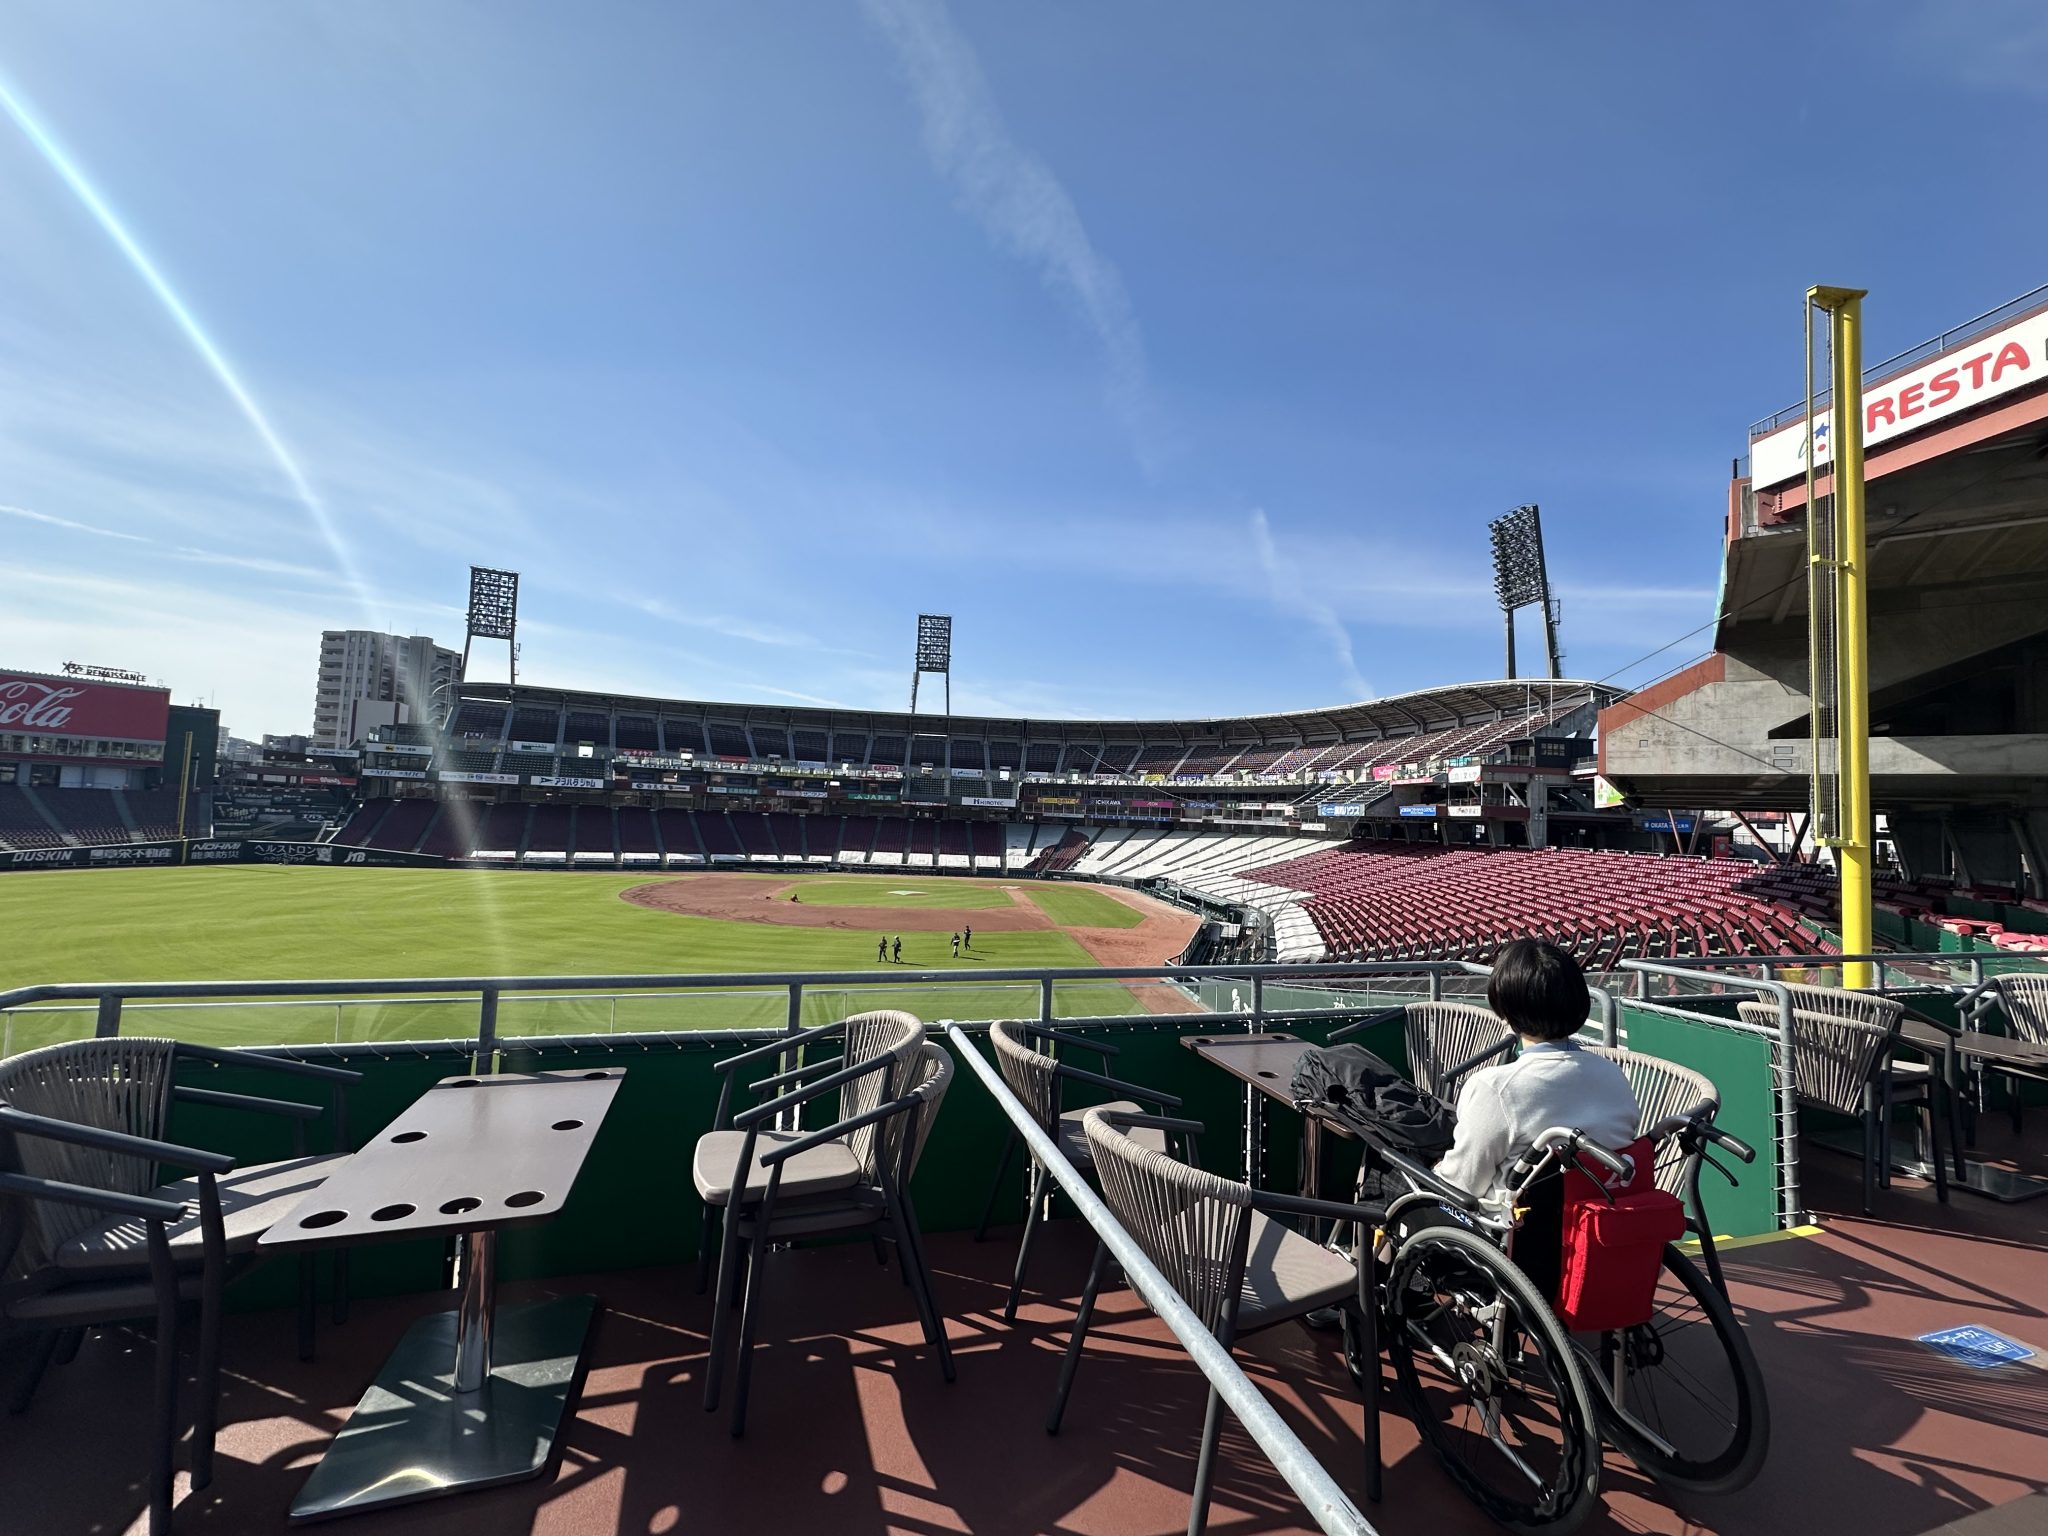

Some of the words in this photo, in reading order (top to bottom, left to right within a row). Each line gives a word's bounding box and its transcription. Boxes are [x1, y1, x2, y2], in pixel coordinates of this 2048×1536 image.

[87, 669, 147, 682] RENAISSANCE
[192, 842, 241, 850] NOHMI
[255, 845, 316, 854] ヘルストロン
[12, 851, 72, 862] DUSKIN
[191, 850, 240, 859] 能美防災
[344, 851, 366, 863] JTB
